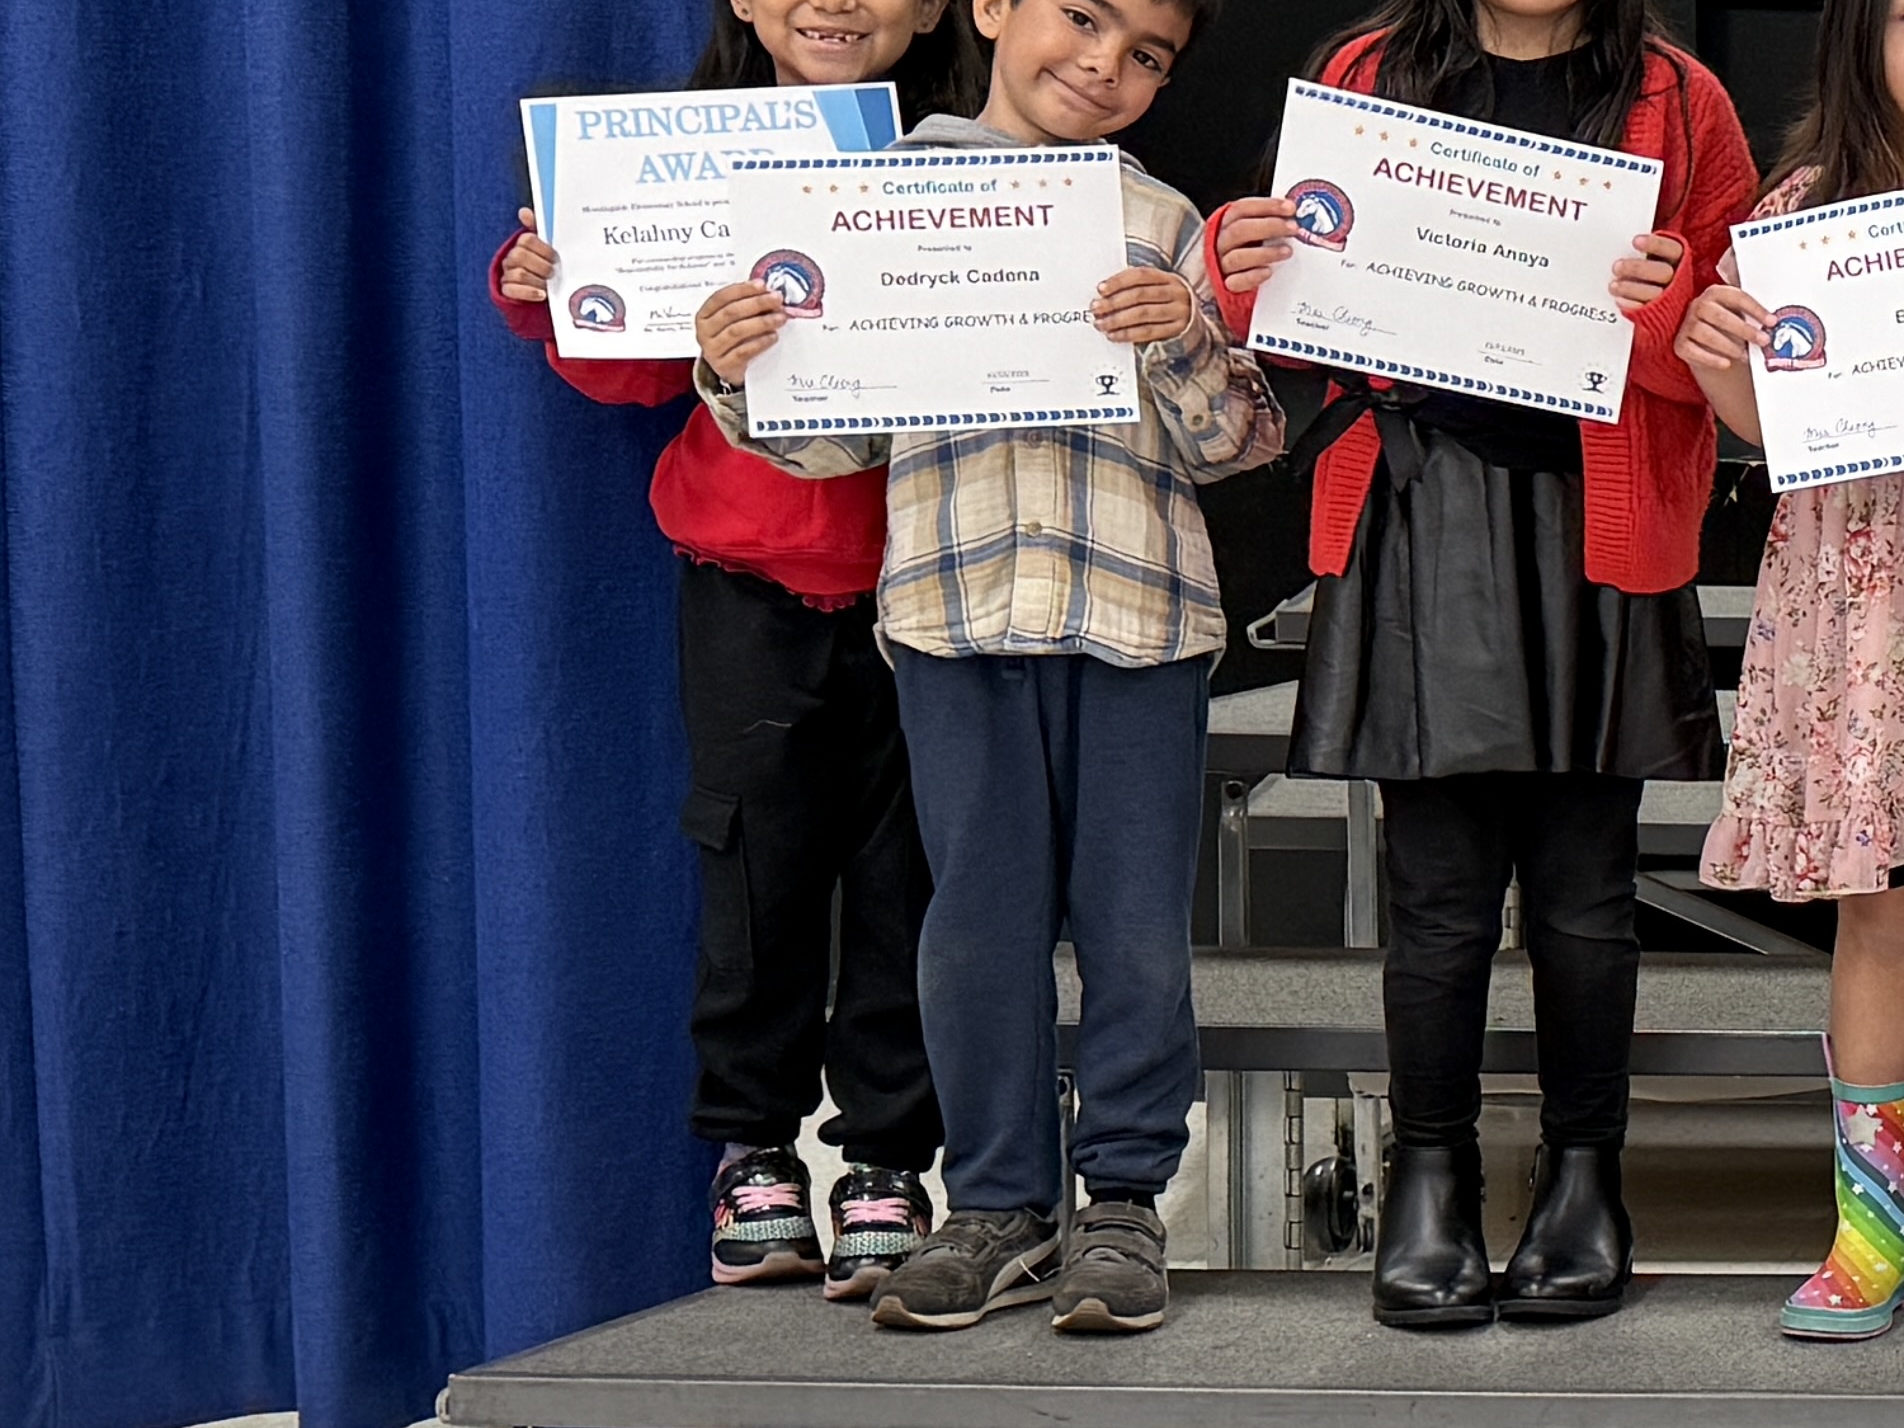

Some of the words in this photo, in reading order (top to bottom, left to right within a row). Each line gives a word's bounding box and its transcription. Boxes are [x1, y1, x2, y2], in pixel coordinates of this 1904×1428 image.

[575, 97, 817, 140] PRINCIPAL'S
[637, 149, 776, 183] AWA
[1430, 141, 1517, 172] Certificate
[1523, 165, 1540, 177] of
[882, 180, 974, 195] Certificate
[980, 179, 997, 192] of
[1373, 158, 1588, 221] ACHIEVEMENT
[603, 224, 692, 245] Kelahny
[700, 220, 730, 238] Ca
[831, 205, 1054, 232] ACHIEVEMENT
[1417, 227, 1487, 253] Victoria
[1366, 262, 1453, 288] ACHIEVING
[1457, 280, 1524, 304] GROWTH
[849, 316, 939, 331] ACHIEVING
[944, 314, 1014, 328] GROWTH
[1019, 313, 1028, 325] &
[1033, 309, 1093, 324] PROGRE
